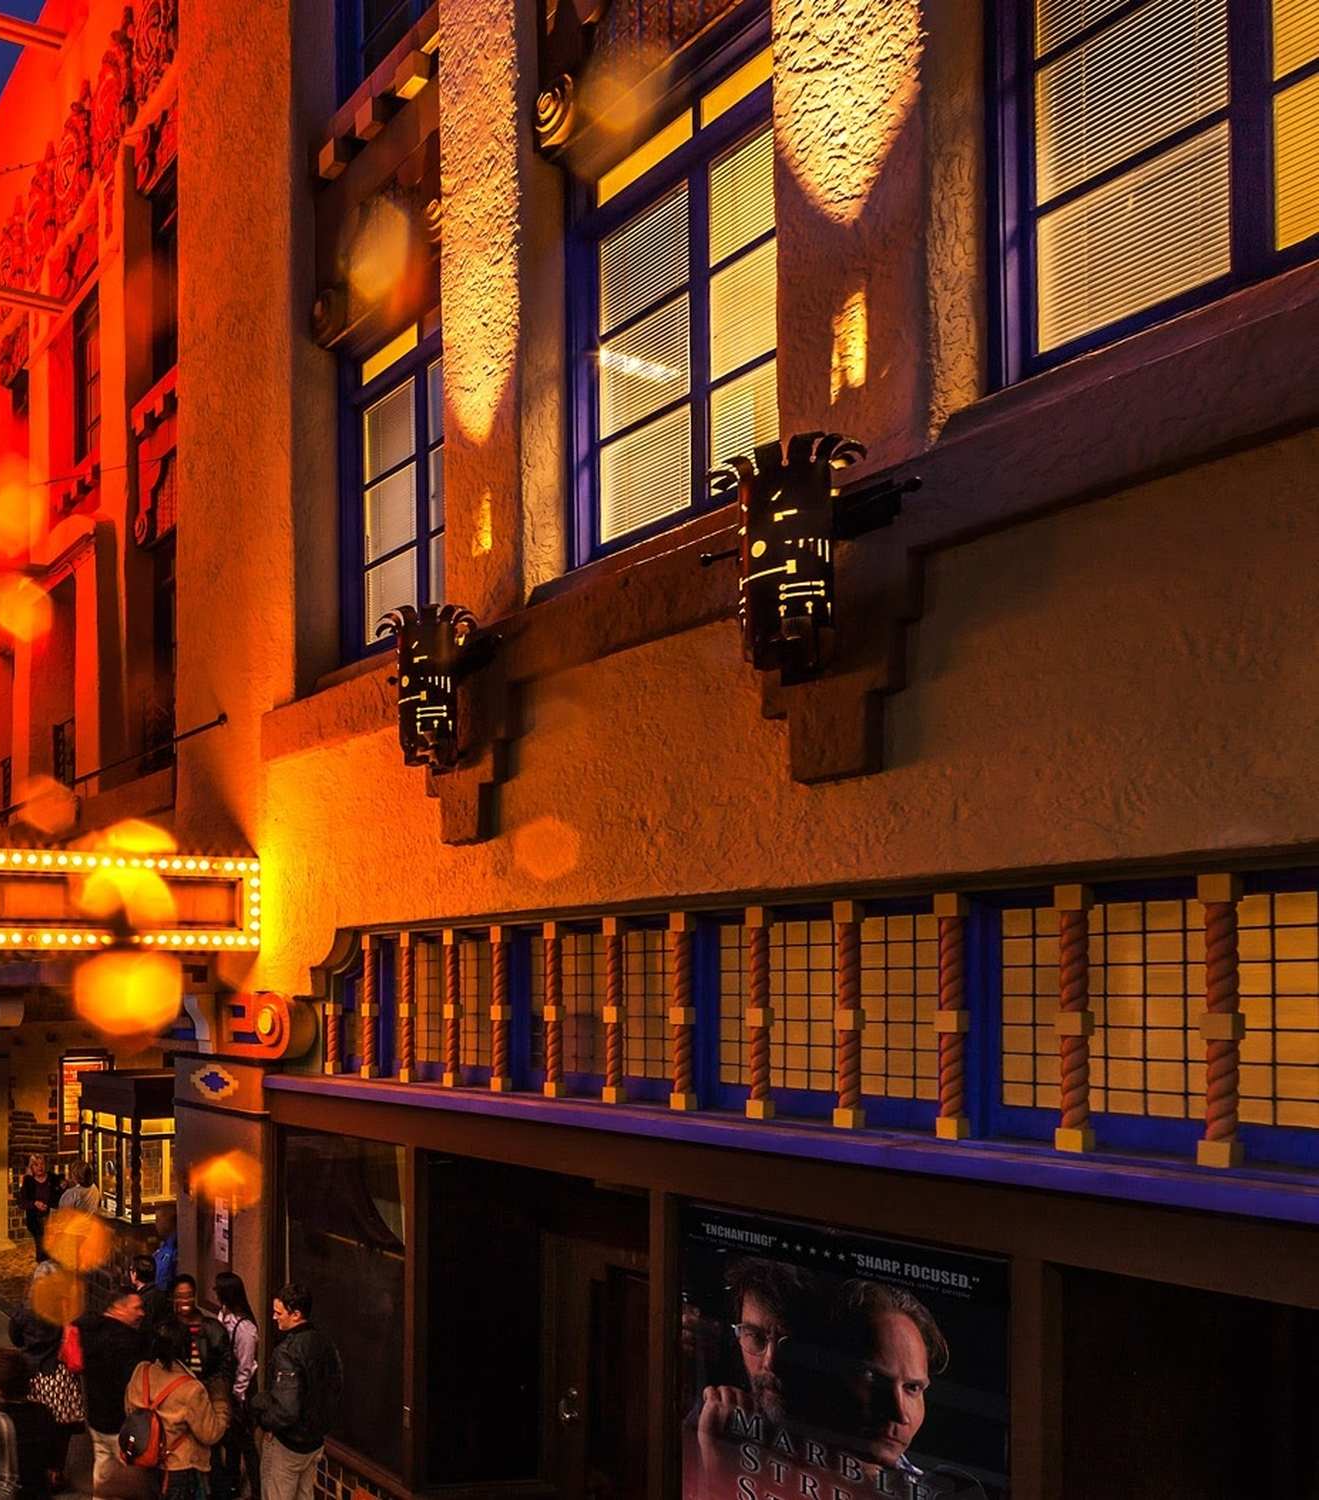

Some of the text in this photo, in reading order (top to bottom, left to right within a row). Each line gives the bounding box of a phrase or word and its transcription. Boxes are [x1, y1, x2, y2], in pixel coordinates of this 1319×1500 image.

[700, 1222, 778, 1248] "ENCHANTING!"
[850, 1251, 902, 1276] "SHARP.
[903, 1262, 980, 1291] FOCUSED."
[732, 1406, 930, 1500] MARBLE
